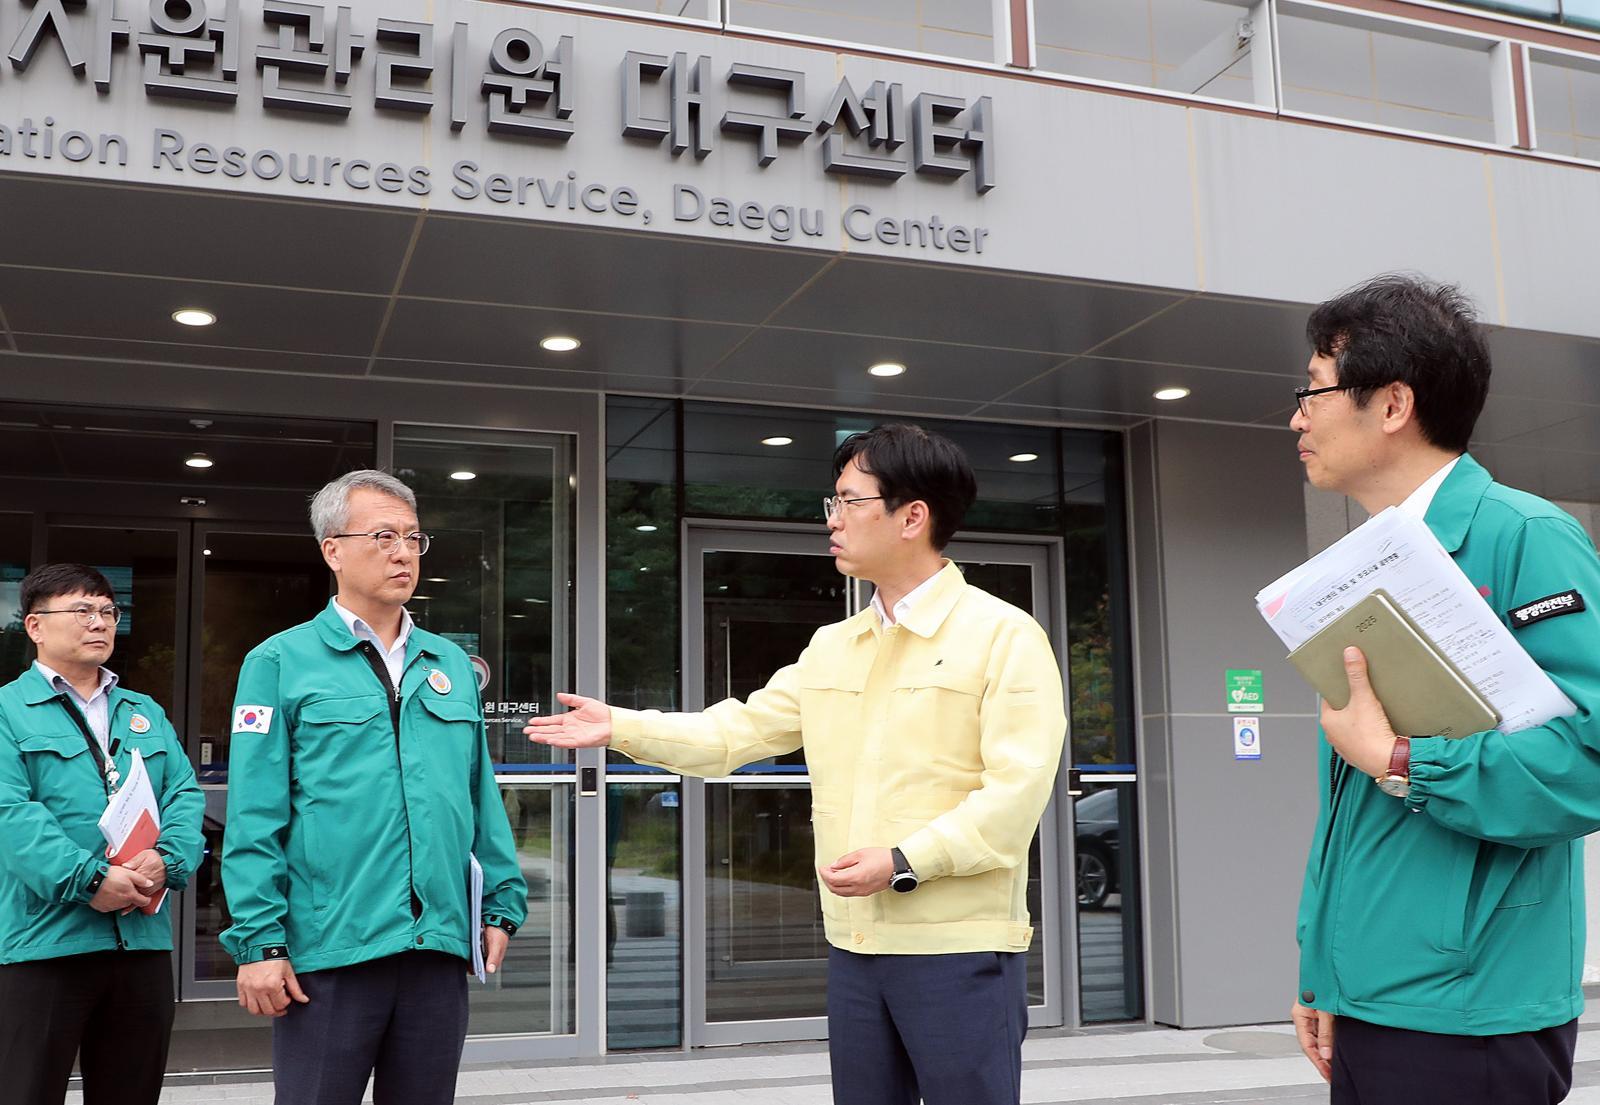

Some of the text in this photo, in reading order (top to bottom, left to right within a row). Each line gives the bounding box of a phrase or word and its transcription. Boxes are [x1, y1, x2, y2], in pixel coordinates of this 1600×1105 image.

[621, 50, 996, 194] 대구센터
[153, 128, 431, 195] Resources
[451, 160, 653, 225] Service,
[674, 183, 824, 242] Daegu
[842, 204, 990, 254] Center
[1514, 594, 1576, 621] 행정안전부
[1354, 615, 1377, 633] 2025
[482, 701, 540, 714] 원 대구센터
[1243, 692, 1259, 701] AED
